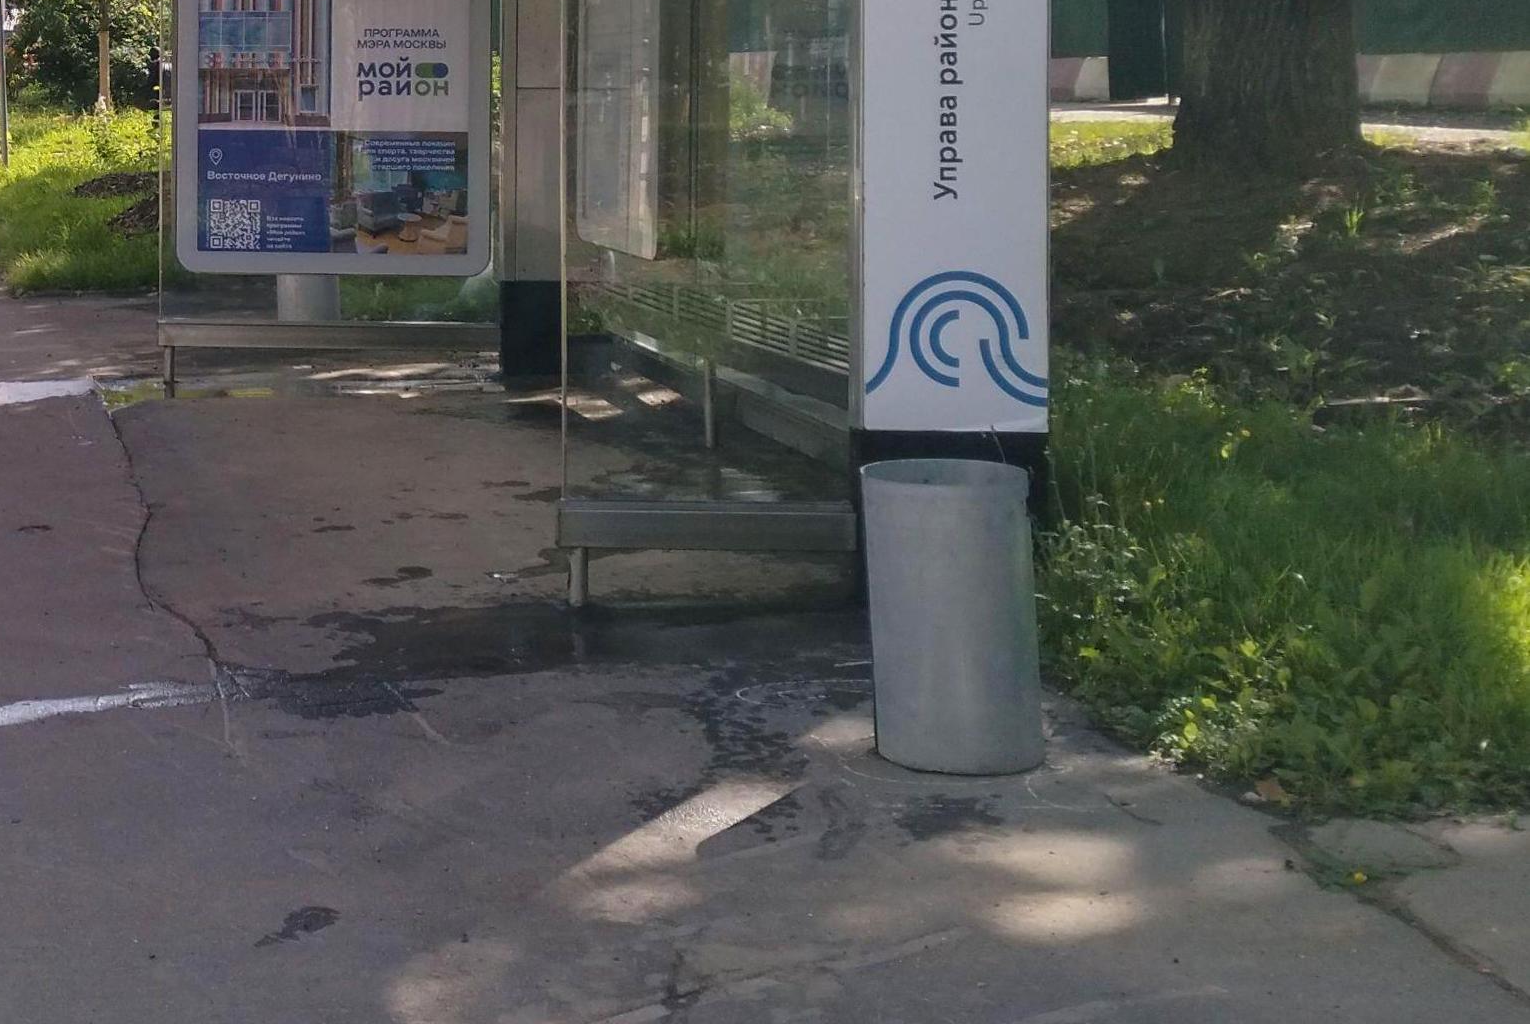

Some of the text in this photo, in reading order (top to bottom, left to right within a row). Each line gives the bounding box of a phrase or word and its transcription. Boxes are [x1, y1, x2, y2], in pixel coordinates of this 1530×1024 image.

[364, 28, 440, 37] ПРОГРАММА
[357, 39, 447, 49] МЭРА МОСКВЫ
[357, 56, 412, 78] мой
[933, 95, 963, 201] Управа
[207, 170, 322, 182] Восточное Дегунино
